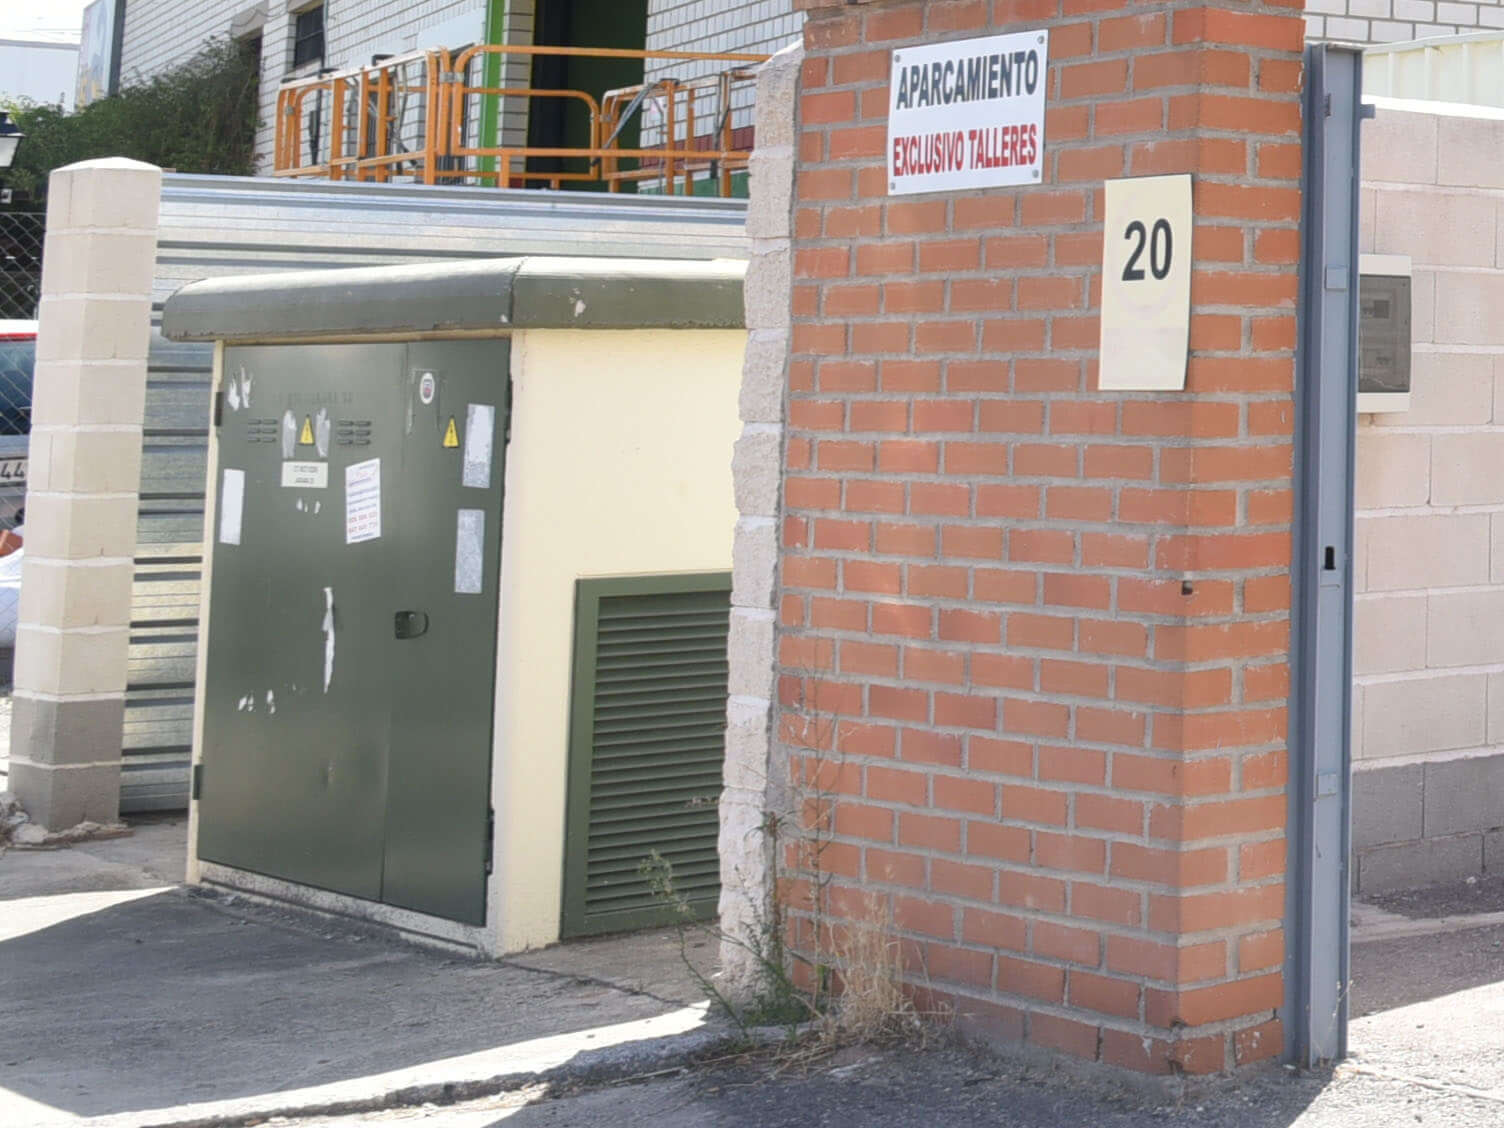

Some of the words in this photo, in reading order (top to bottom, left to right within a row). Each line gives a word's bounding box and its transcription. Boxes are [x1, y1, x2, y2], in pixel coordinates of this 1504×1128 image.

[896, 49, 1038, 110] APARCAMIENTO
[893, 131, 964, 176] EXCLUSIVO
[969, 123, 1037, 170] TALLERES
[1121, 218, 1173, 281] 20
